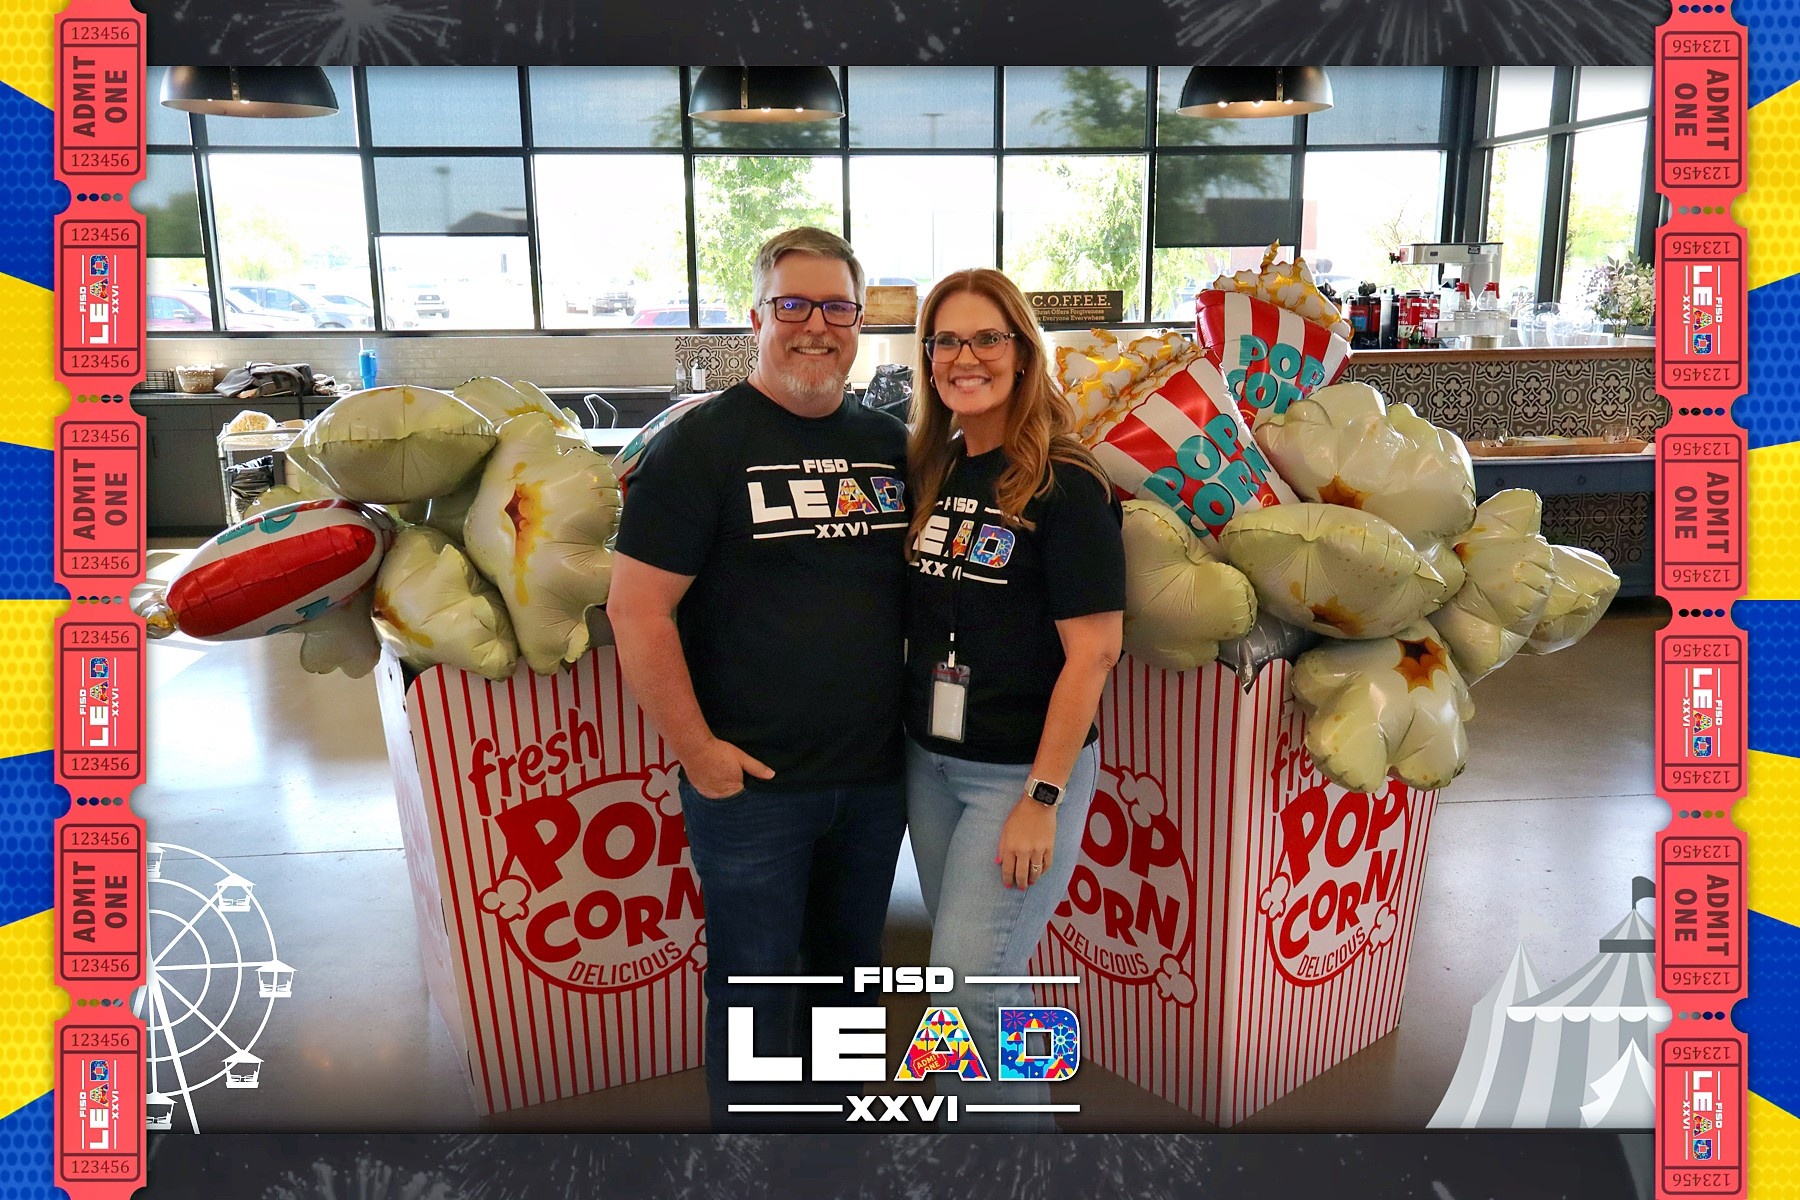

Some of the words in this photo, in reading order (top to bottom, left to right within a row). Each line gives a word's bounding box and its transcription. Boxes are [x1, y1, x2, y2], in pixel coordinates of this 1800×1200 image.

[1032, 294, 1111, 307] C.O.F.F.E.E.
[1239, 334, 1326, 389] POP
[1227, 368, 1305, 415] COR
[802, 458, 849, 474] FISD
[1143, 413, 1239, 508] POP
[747, 475, 906, 524] LEAD
[943, 496, 979, 514] FISD
[1175, 440, 1272, 539] CORN
[814, 521, 869, 539] XXVI
[912, 514, 1016, 569] EAD
[468, 707, 601, 817] fresh
[1270, 731, 1315, 815] fre
[1081, 789, 1182, 879] OP
[1280, 779, 1406, 889] POP
[526, 867, 706, 963] CORN
[1054, 864, 1181, 951] ORN
[1279, 848, 1399, 960] CORN
[567, 941, 683, 986] DELICIOUS
[1062, 922, 1150, 976] DELICIOUS
[1296, 925, 1366, 978] DELICIOUS
